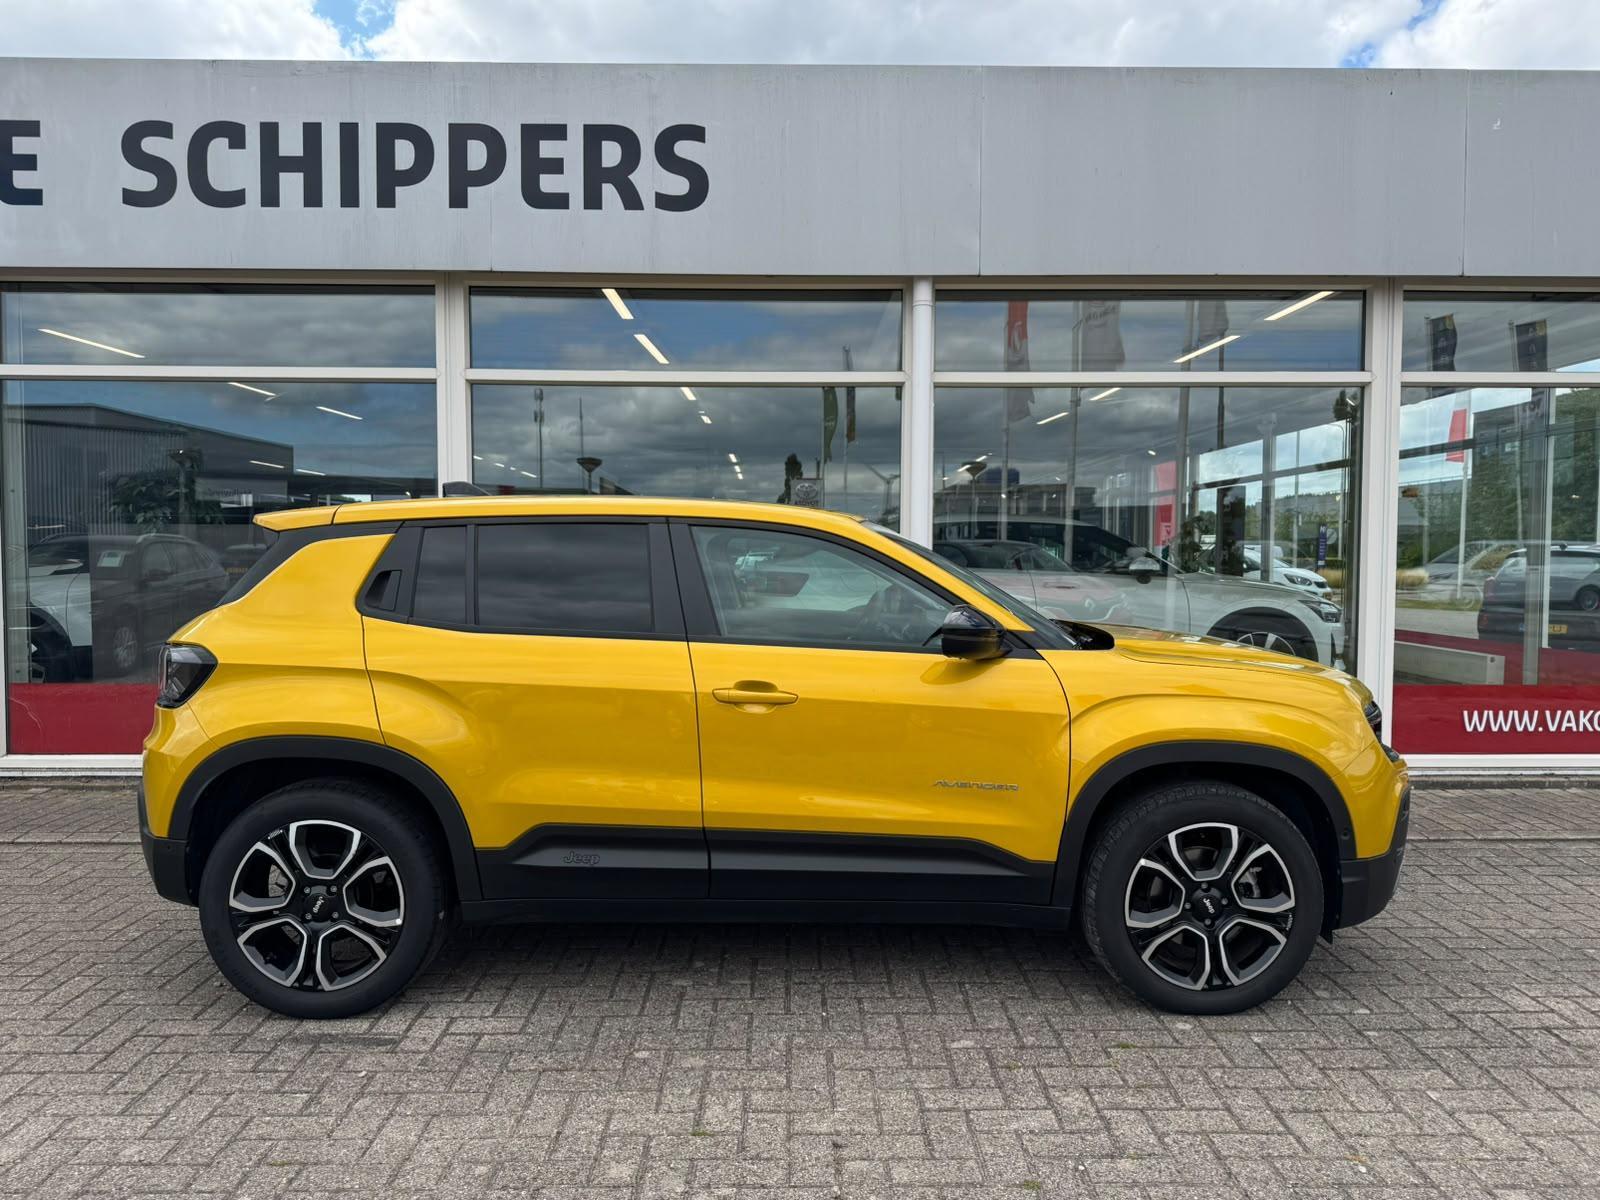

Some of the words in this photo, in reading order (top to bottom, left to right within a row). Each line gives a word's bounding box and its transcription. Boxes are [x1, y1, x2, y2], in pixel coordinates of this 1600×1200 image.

[120, 119, 710, 212] SCHIPPERS
[932, 779, 1020, 792] AVENGER
[563, 850, 601, 867] Jeep
